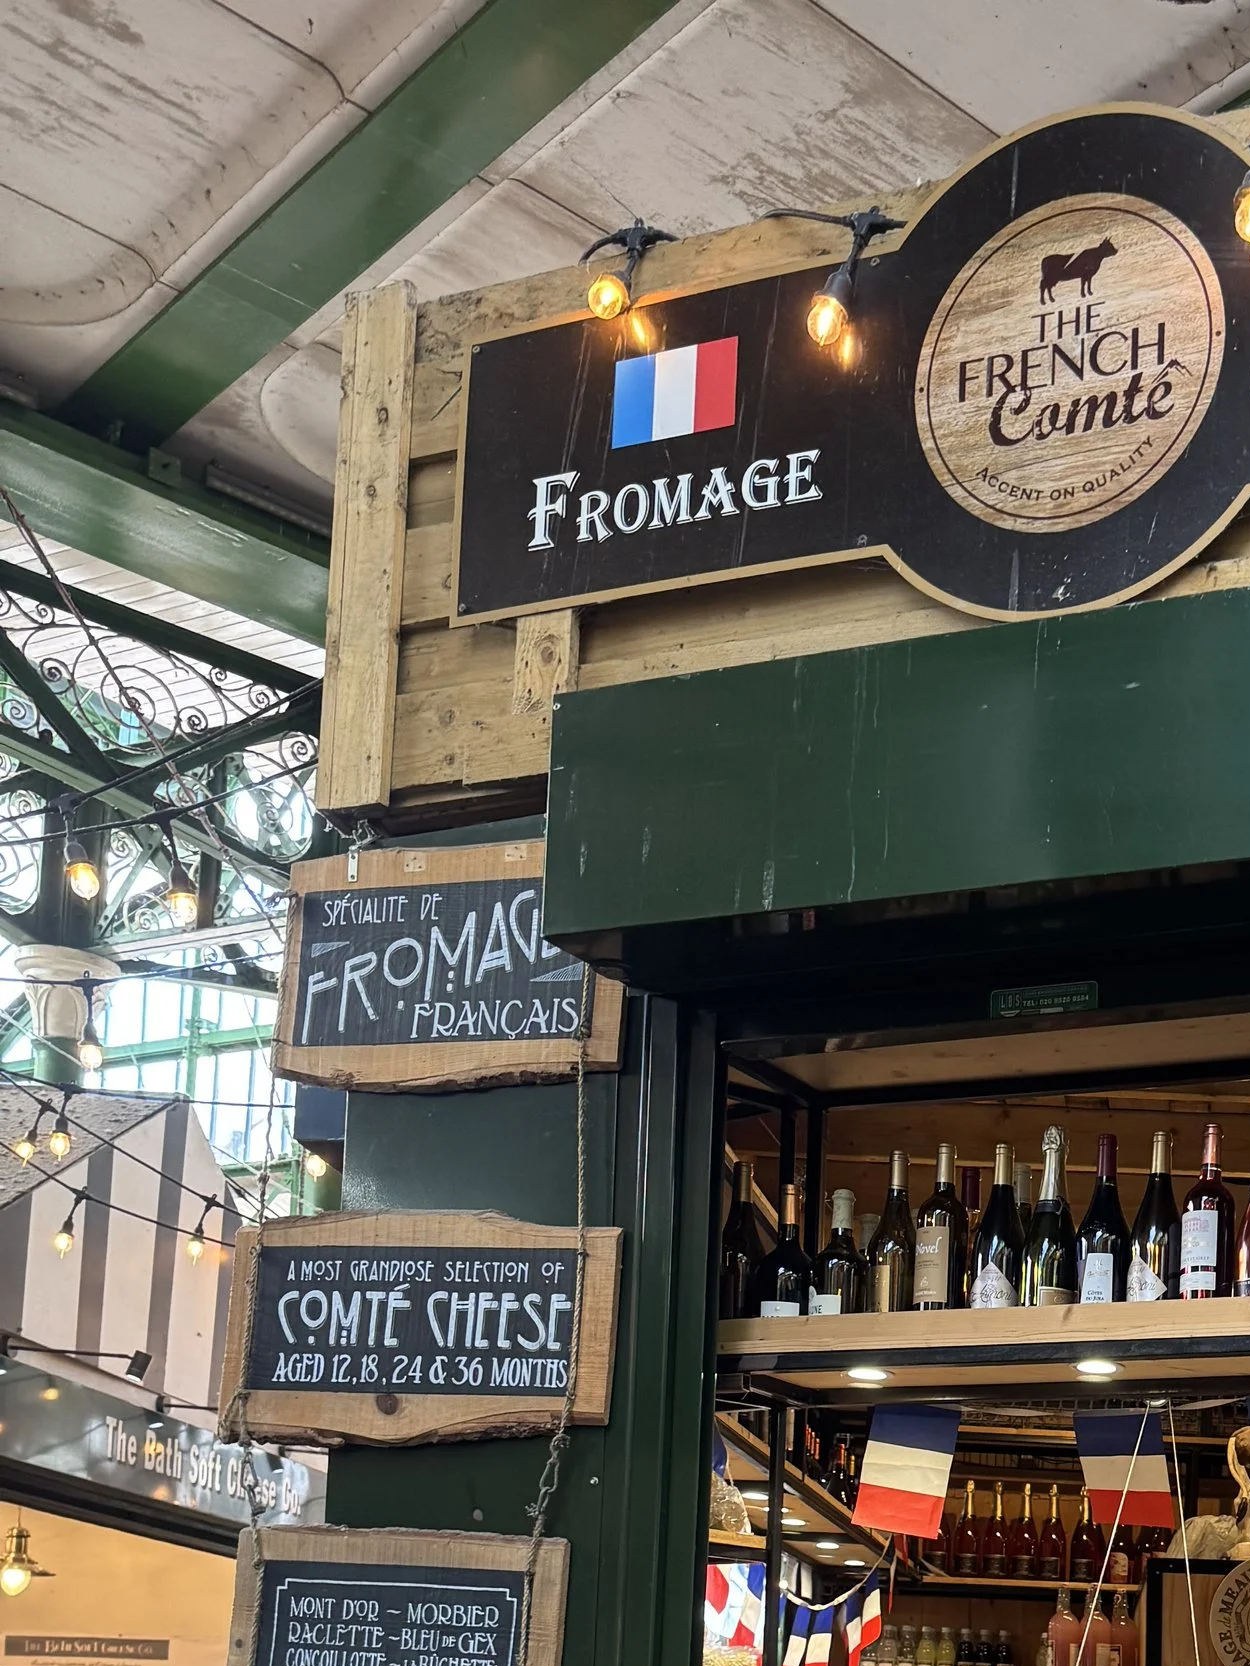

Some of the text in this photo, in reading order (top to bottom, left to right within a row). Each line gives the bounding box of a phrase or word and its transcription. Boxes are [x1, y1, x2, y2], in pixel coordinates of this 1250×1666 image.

[1032, 301, 1106, 342] THE
[958, 322, 1165, 403] FRENCH
[975, 436, 1153, 501] ACCENT ON QUALITY
[526, 448, 823, 552] FROMAGE
[322, 893, 442, 926] SPÉCIALITE DE
[302, 889, 560, 1045] FROMAG
[410, 998, 579, 1039] FRANÇAIS
[287, 1261, 564, 1283] A MOST GRANDIOSE SELECTION OF
[278, 1283, 572, 1350] COMTÉ CHEESE
[272, 1353, 324, 1382] AGED
[392, 1356, 422, 1383] 24
[428, 1356, 448, 1384] &
[452, 1358, 482, 1386] 36
[490, 1358, 568, 1388] MONTHS
[106, 1416, 137, 1466] The
[144, 1429, 182, 1481] Bath
[189, 1444, 221, 1493] Soft
[227, 1457, 277, 1508] Chese
[290, 1597, 499, 1627] MONT D'OR MORBIER
[288, 1622, 496, 1655] RACLETTE BLEU DE GEX
